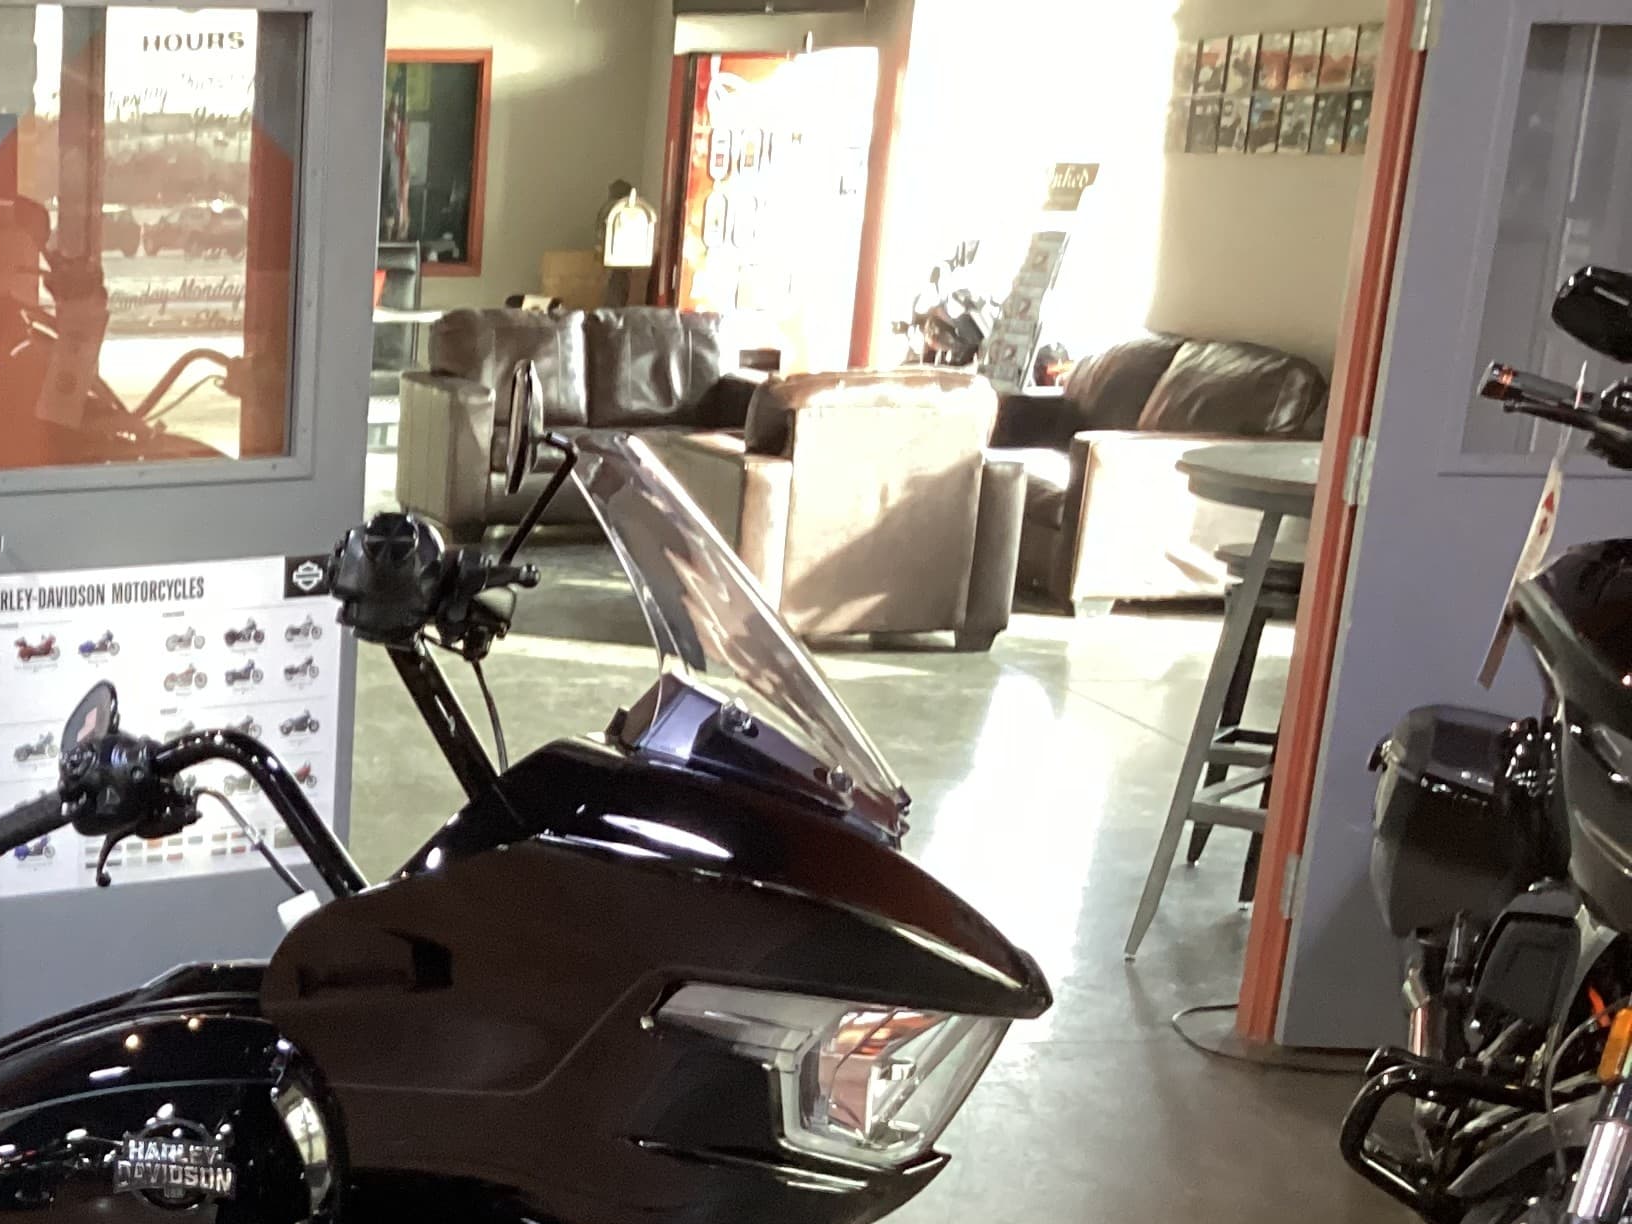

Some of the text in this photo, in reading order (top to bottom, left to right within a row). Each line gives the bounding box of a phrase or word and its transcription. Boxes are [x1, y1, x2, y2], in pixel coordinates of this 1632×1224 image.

[143, 31, 245, 52] HOURS
[111, 576, 205, 606] MOTORCYCLES
[128, 1139, 220, 1165] HARLEY
[117, 1160, 233, 1193] DAVIDSON
